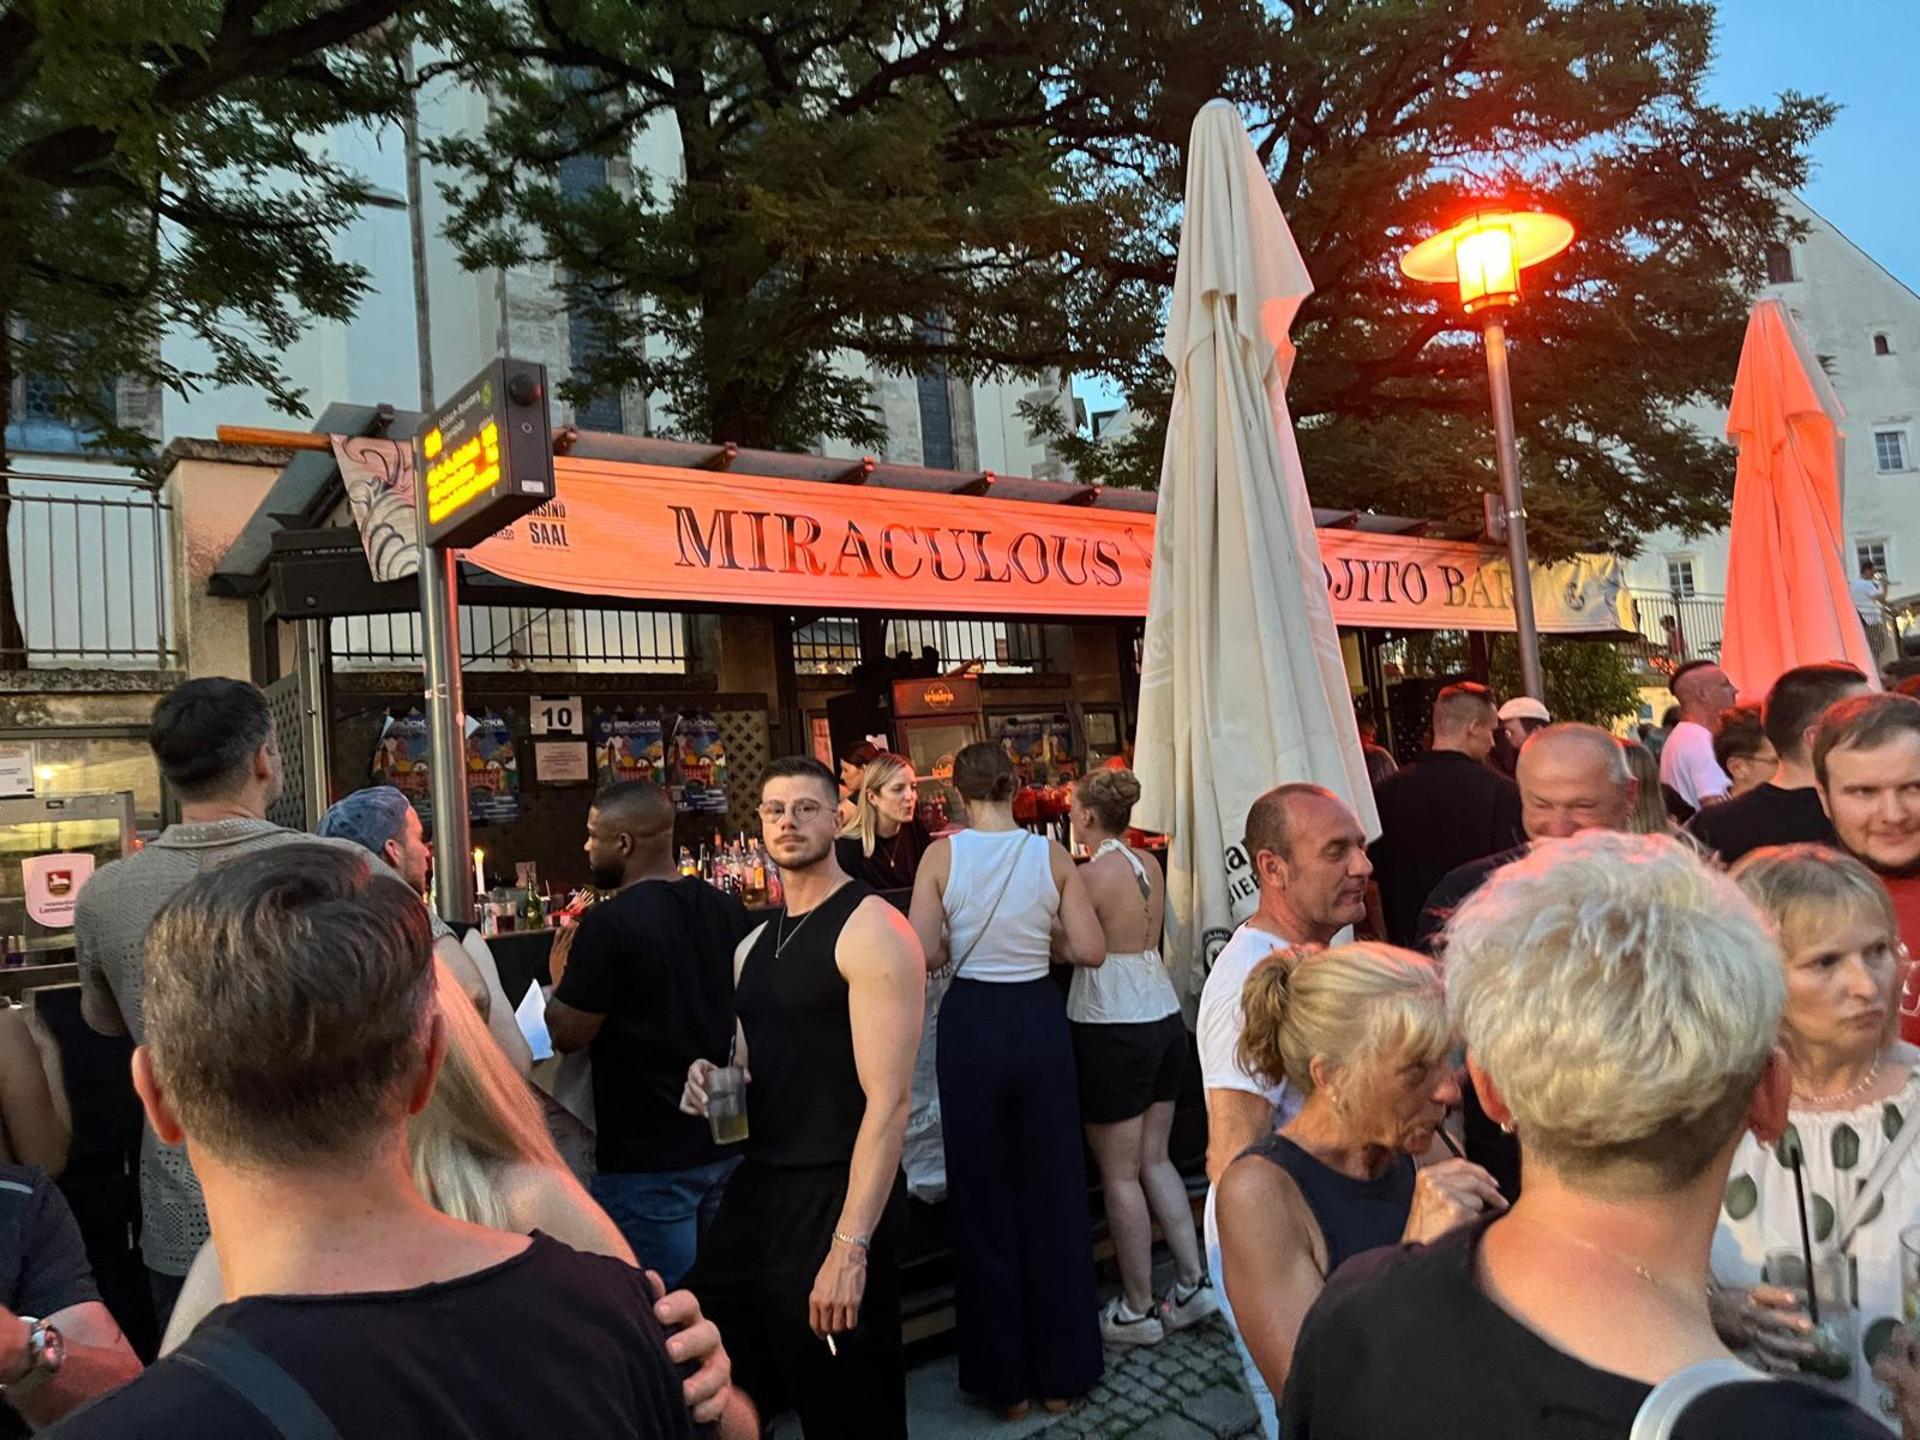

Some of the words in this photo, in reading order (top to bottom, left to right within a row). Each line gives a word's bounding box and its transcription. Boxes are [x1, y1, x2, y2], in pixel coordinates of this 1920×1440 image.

[528, 500, 567, 519] ASINO
[529, 521, 569, 547] SAAL
[667, 505, 1122, 587] MIRACULOUS
[1322, 557, 1429, 605] JITO
[541, 707, 572, 727] 10
